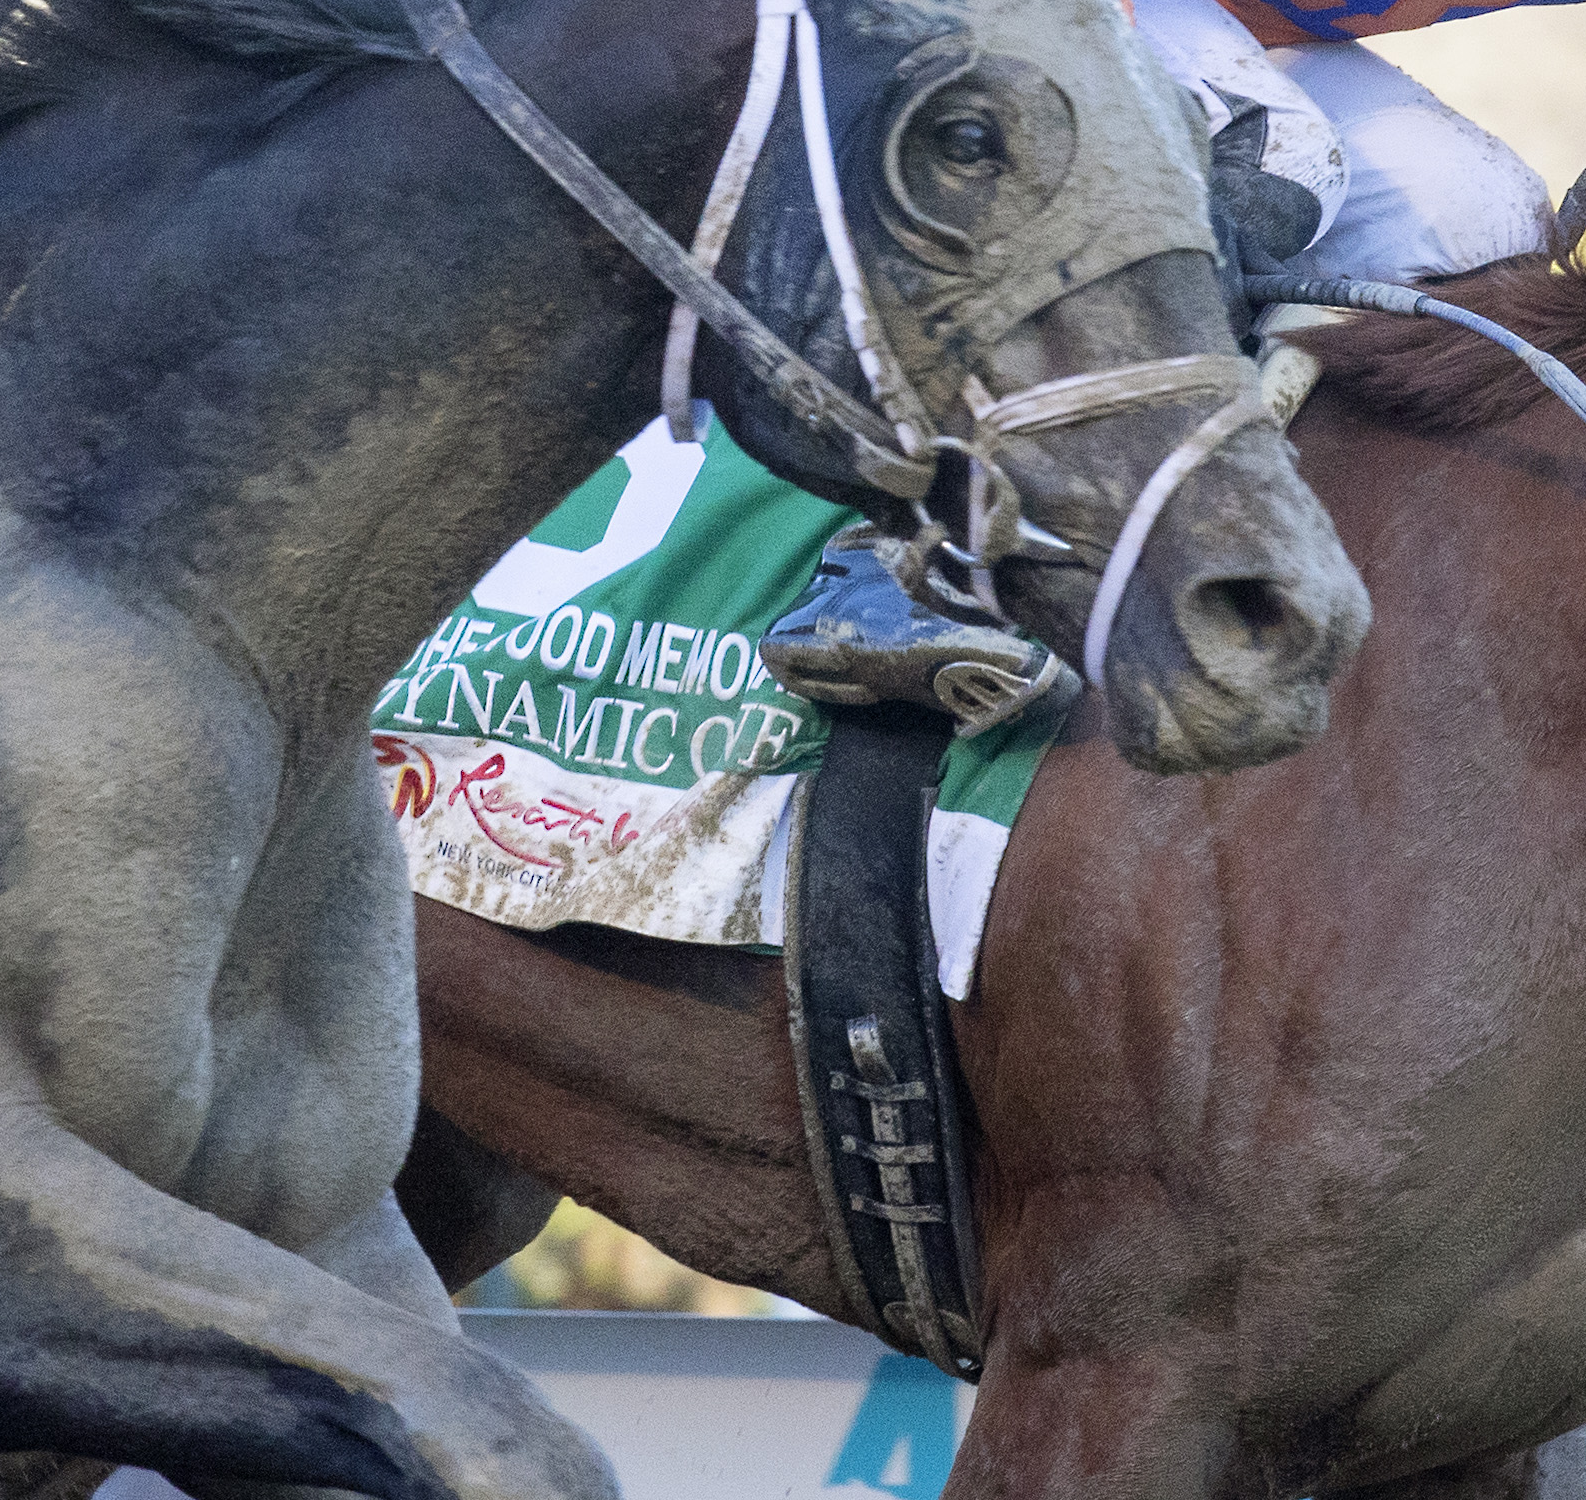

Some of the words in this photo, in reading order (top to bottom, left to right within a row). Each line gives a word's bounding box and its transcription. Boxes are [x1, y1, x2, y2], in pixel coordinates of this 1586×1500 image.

[403, 613, 496, 673] HE
[483, 604, 615, 681] OOD
[614, 618, 787, 703] MEMO
[437, 839, 472, 864] NEW
[475, 852, 516, 882] YORK
